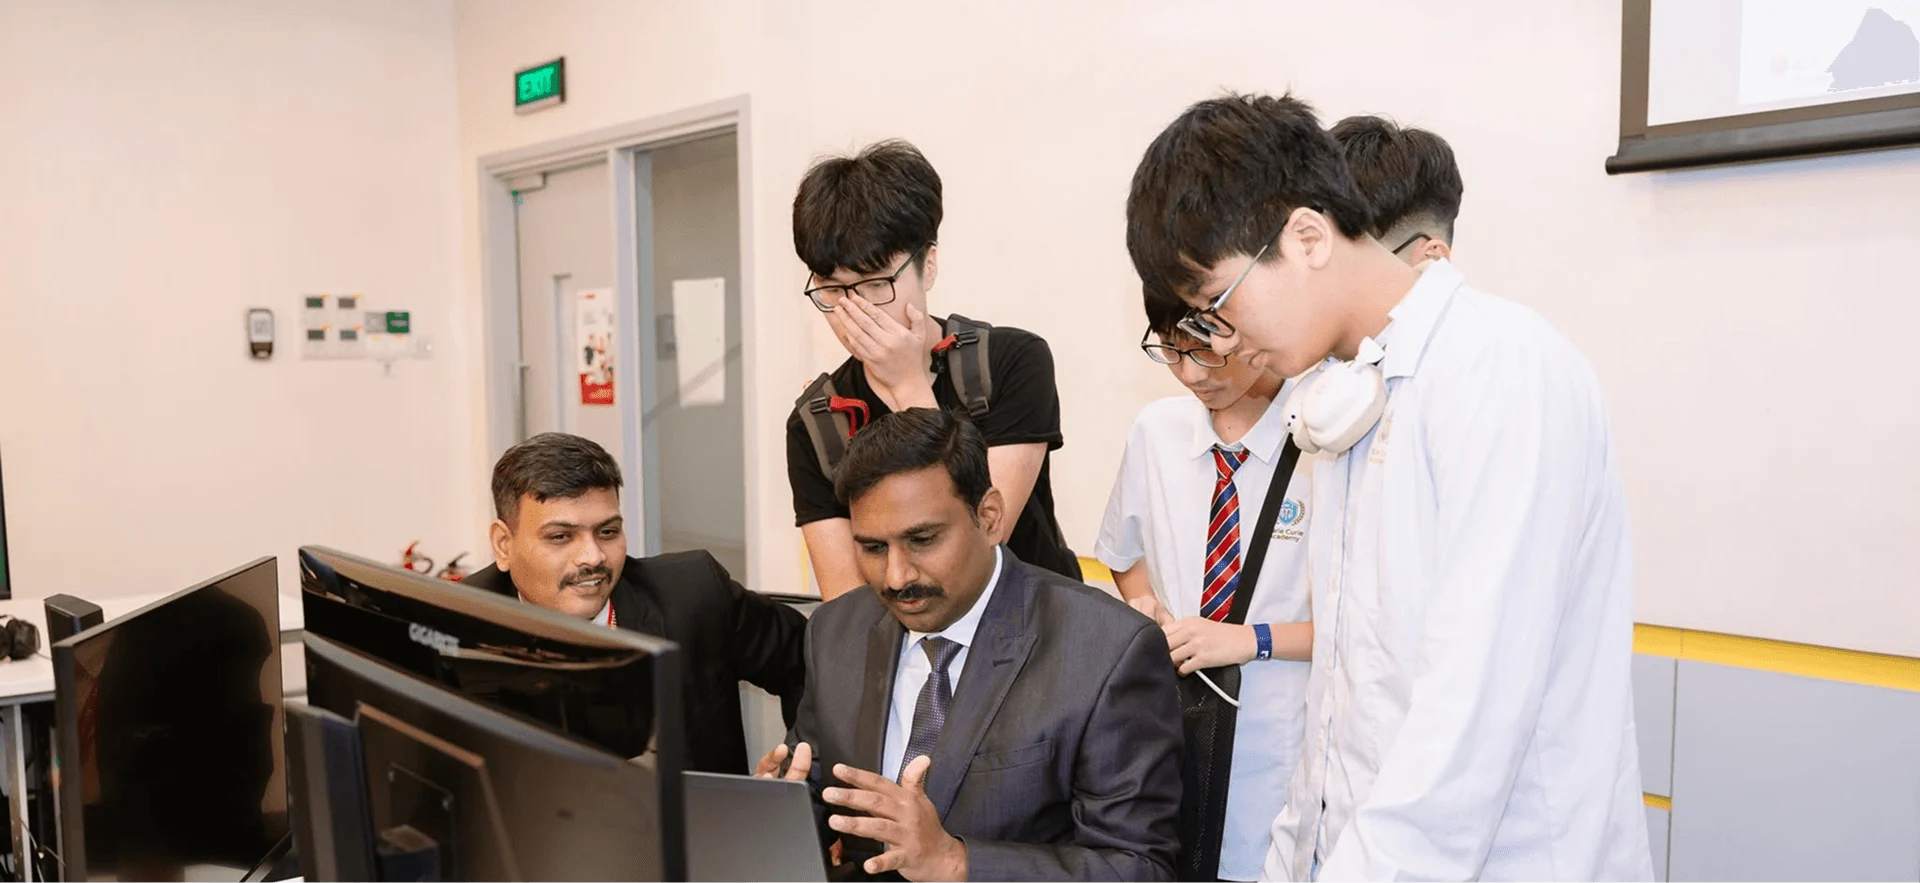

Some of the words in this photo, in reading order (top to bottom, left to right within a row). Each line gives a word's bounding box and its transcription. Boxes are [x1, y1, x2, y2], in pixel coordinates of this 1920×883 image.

[519, 67, 555, 100] EXIT
[1285, 528, 1304, 536] Curie
[1271, 534, 1300, 543] cademy
